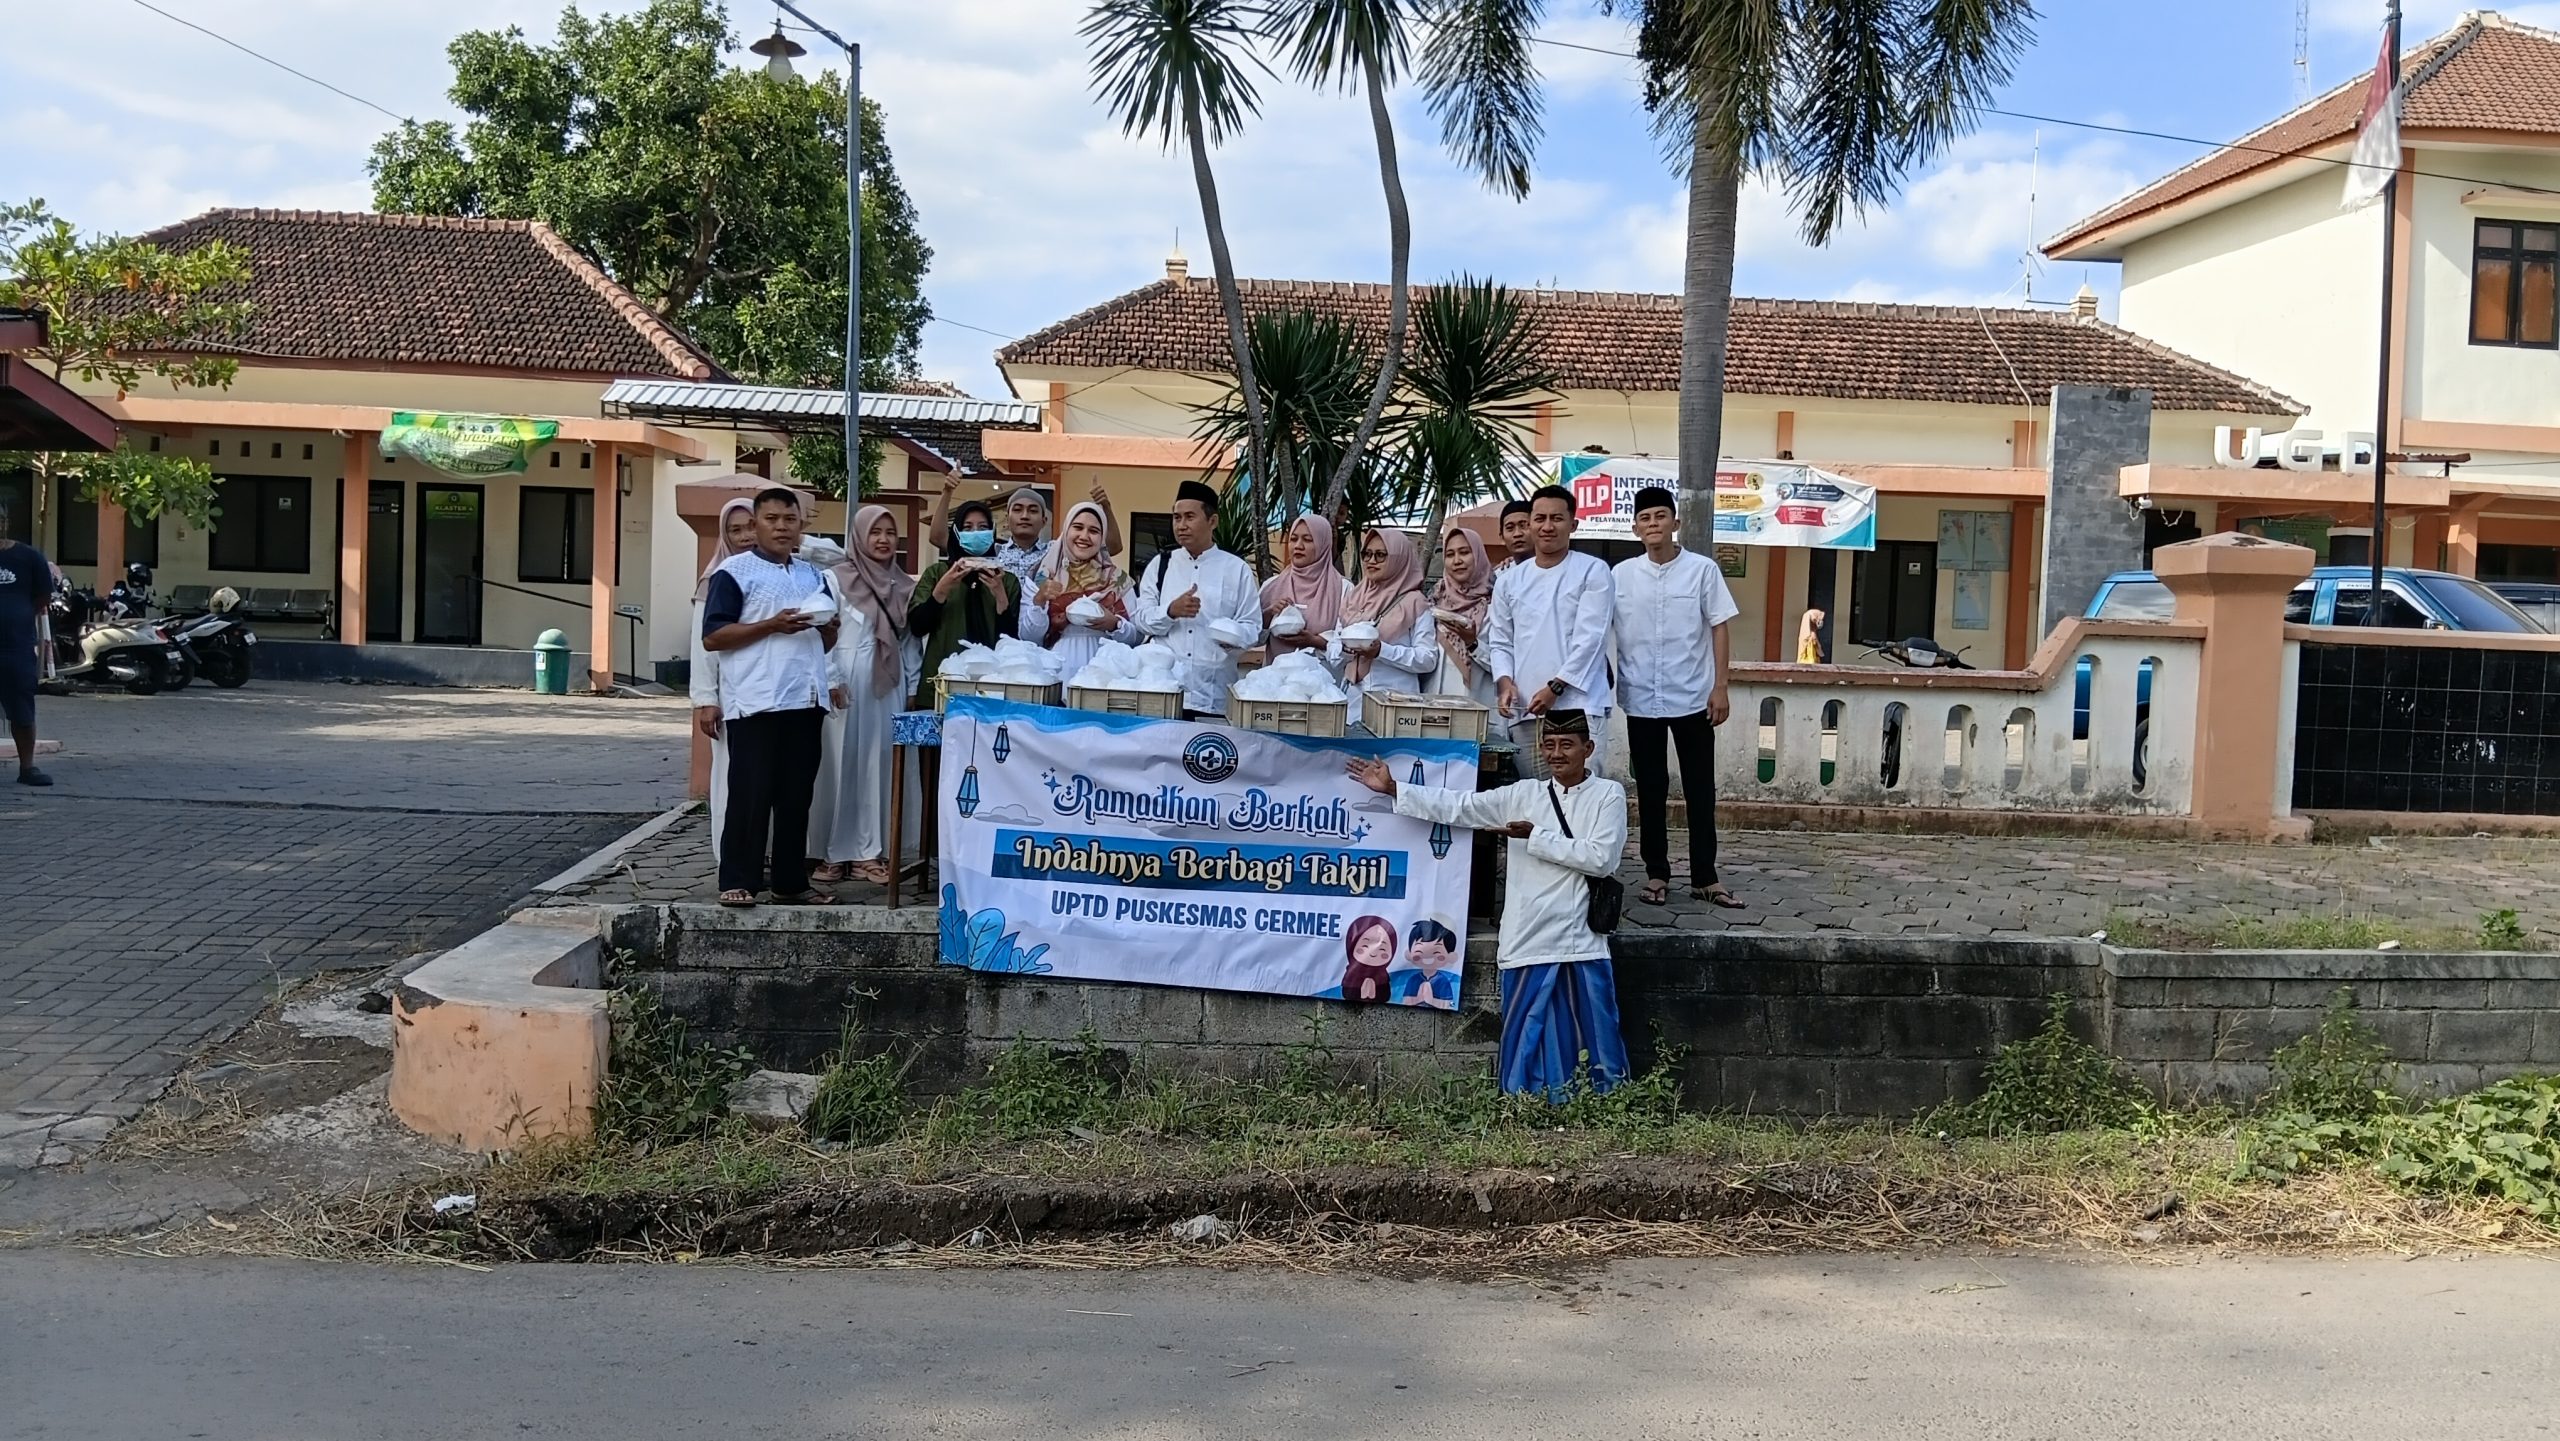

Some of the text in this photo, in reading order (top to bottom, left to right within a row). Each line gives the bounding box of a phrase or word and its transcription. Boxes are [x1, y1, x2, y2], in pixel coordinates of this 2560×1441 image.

[2214, 425, 2376, 473] UGD
[1578, 484, 1609, 508] ILP
[1254, 712, 1273, 721] PSR
[1397, 717, 1417, 726] CKU
[1053, 773, 1350, 839] Ramadhan Berkah
[1015, 836, 1388, 894] Indahnya Berbagi Takjil
[1051, 889, 1342, 938] UPTD PUSKESMAS CERMEE
